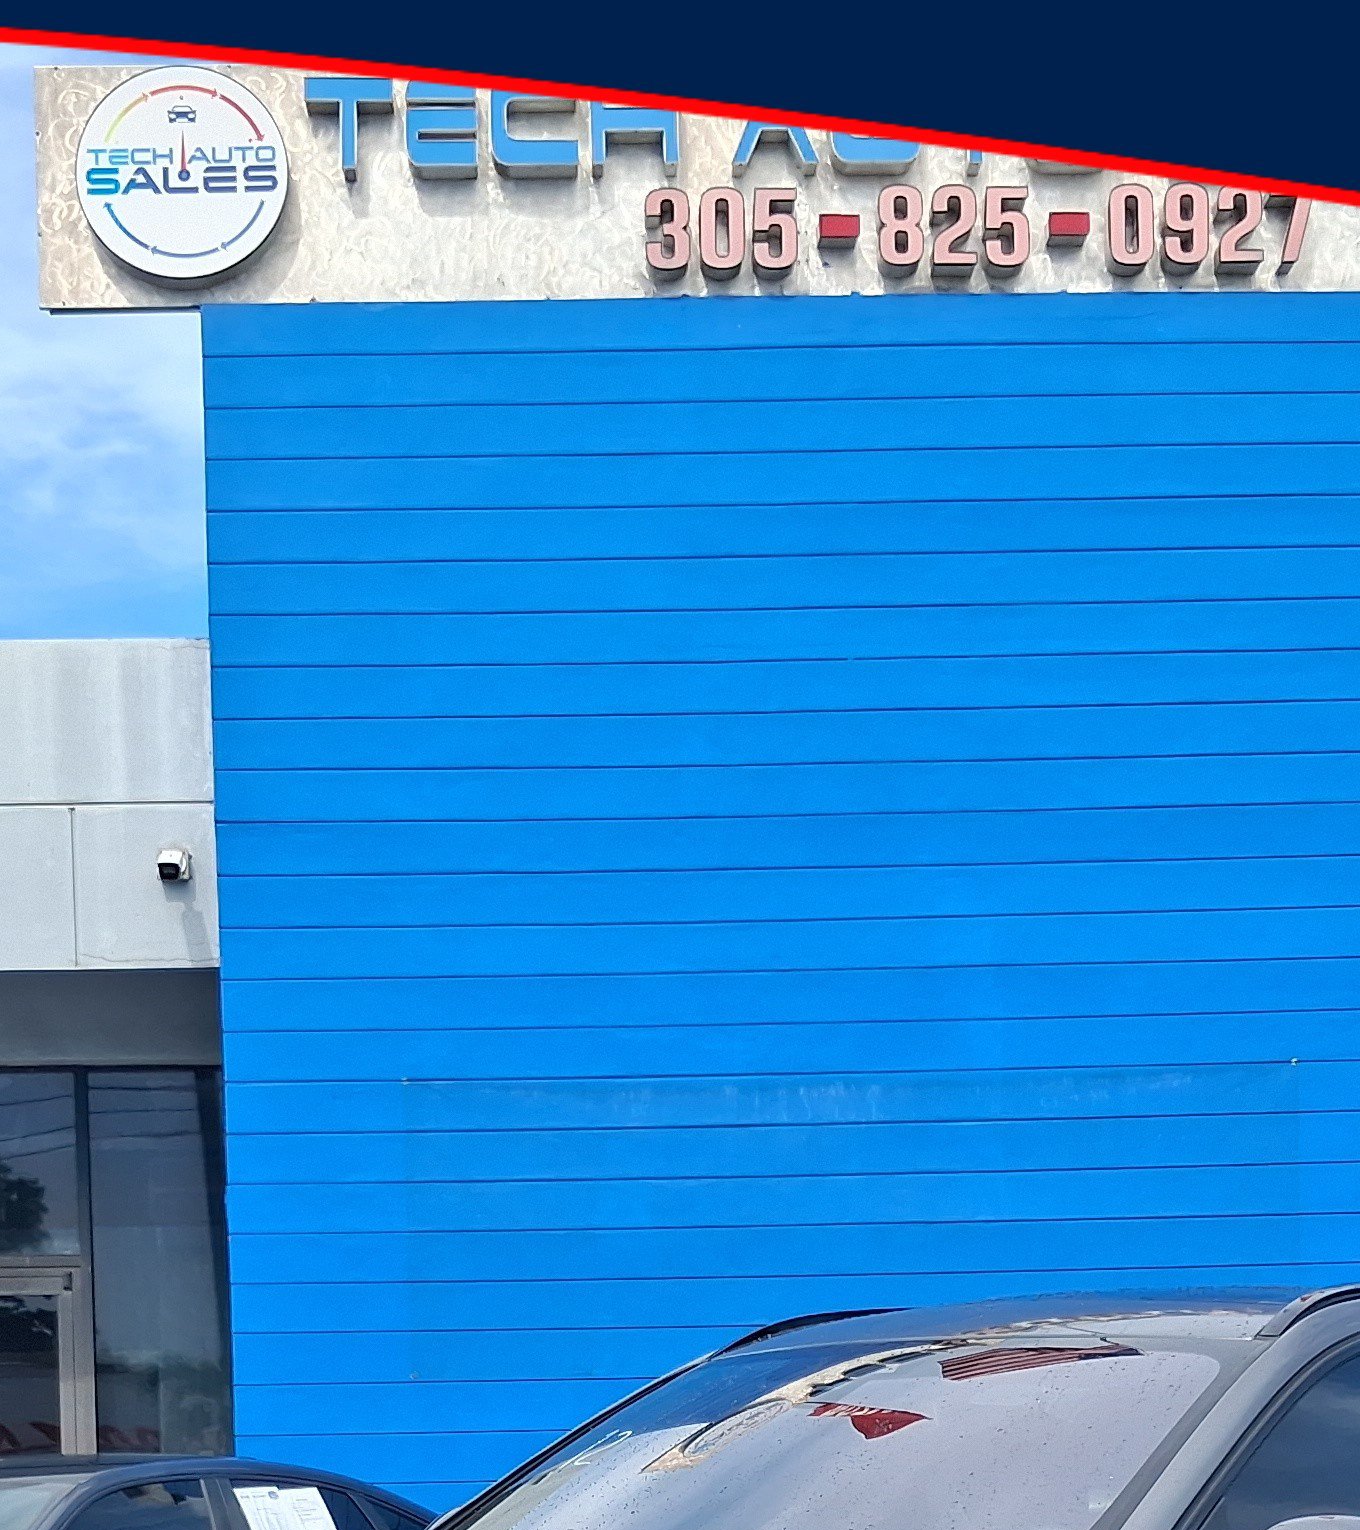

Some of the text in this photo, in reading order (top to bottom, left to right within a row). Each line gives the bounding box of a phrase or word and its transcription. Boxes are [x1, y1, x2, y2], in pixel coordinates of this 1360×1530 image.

[86, 145, 276, 166] TECH AUTO
[85, 165, 279, 196] SALES
[644, 183, 1313, 277] 305-825-0927
